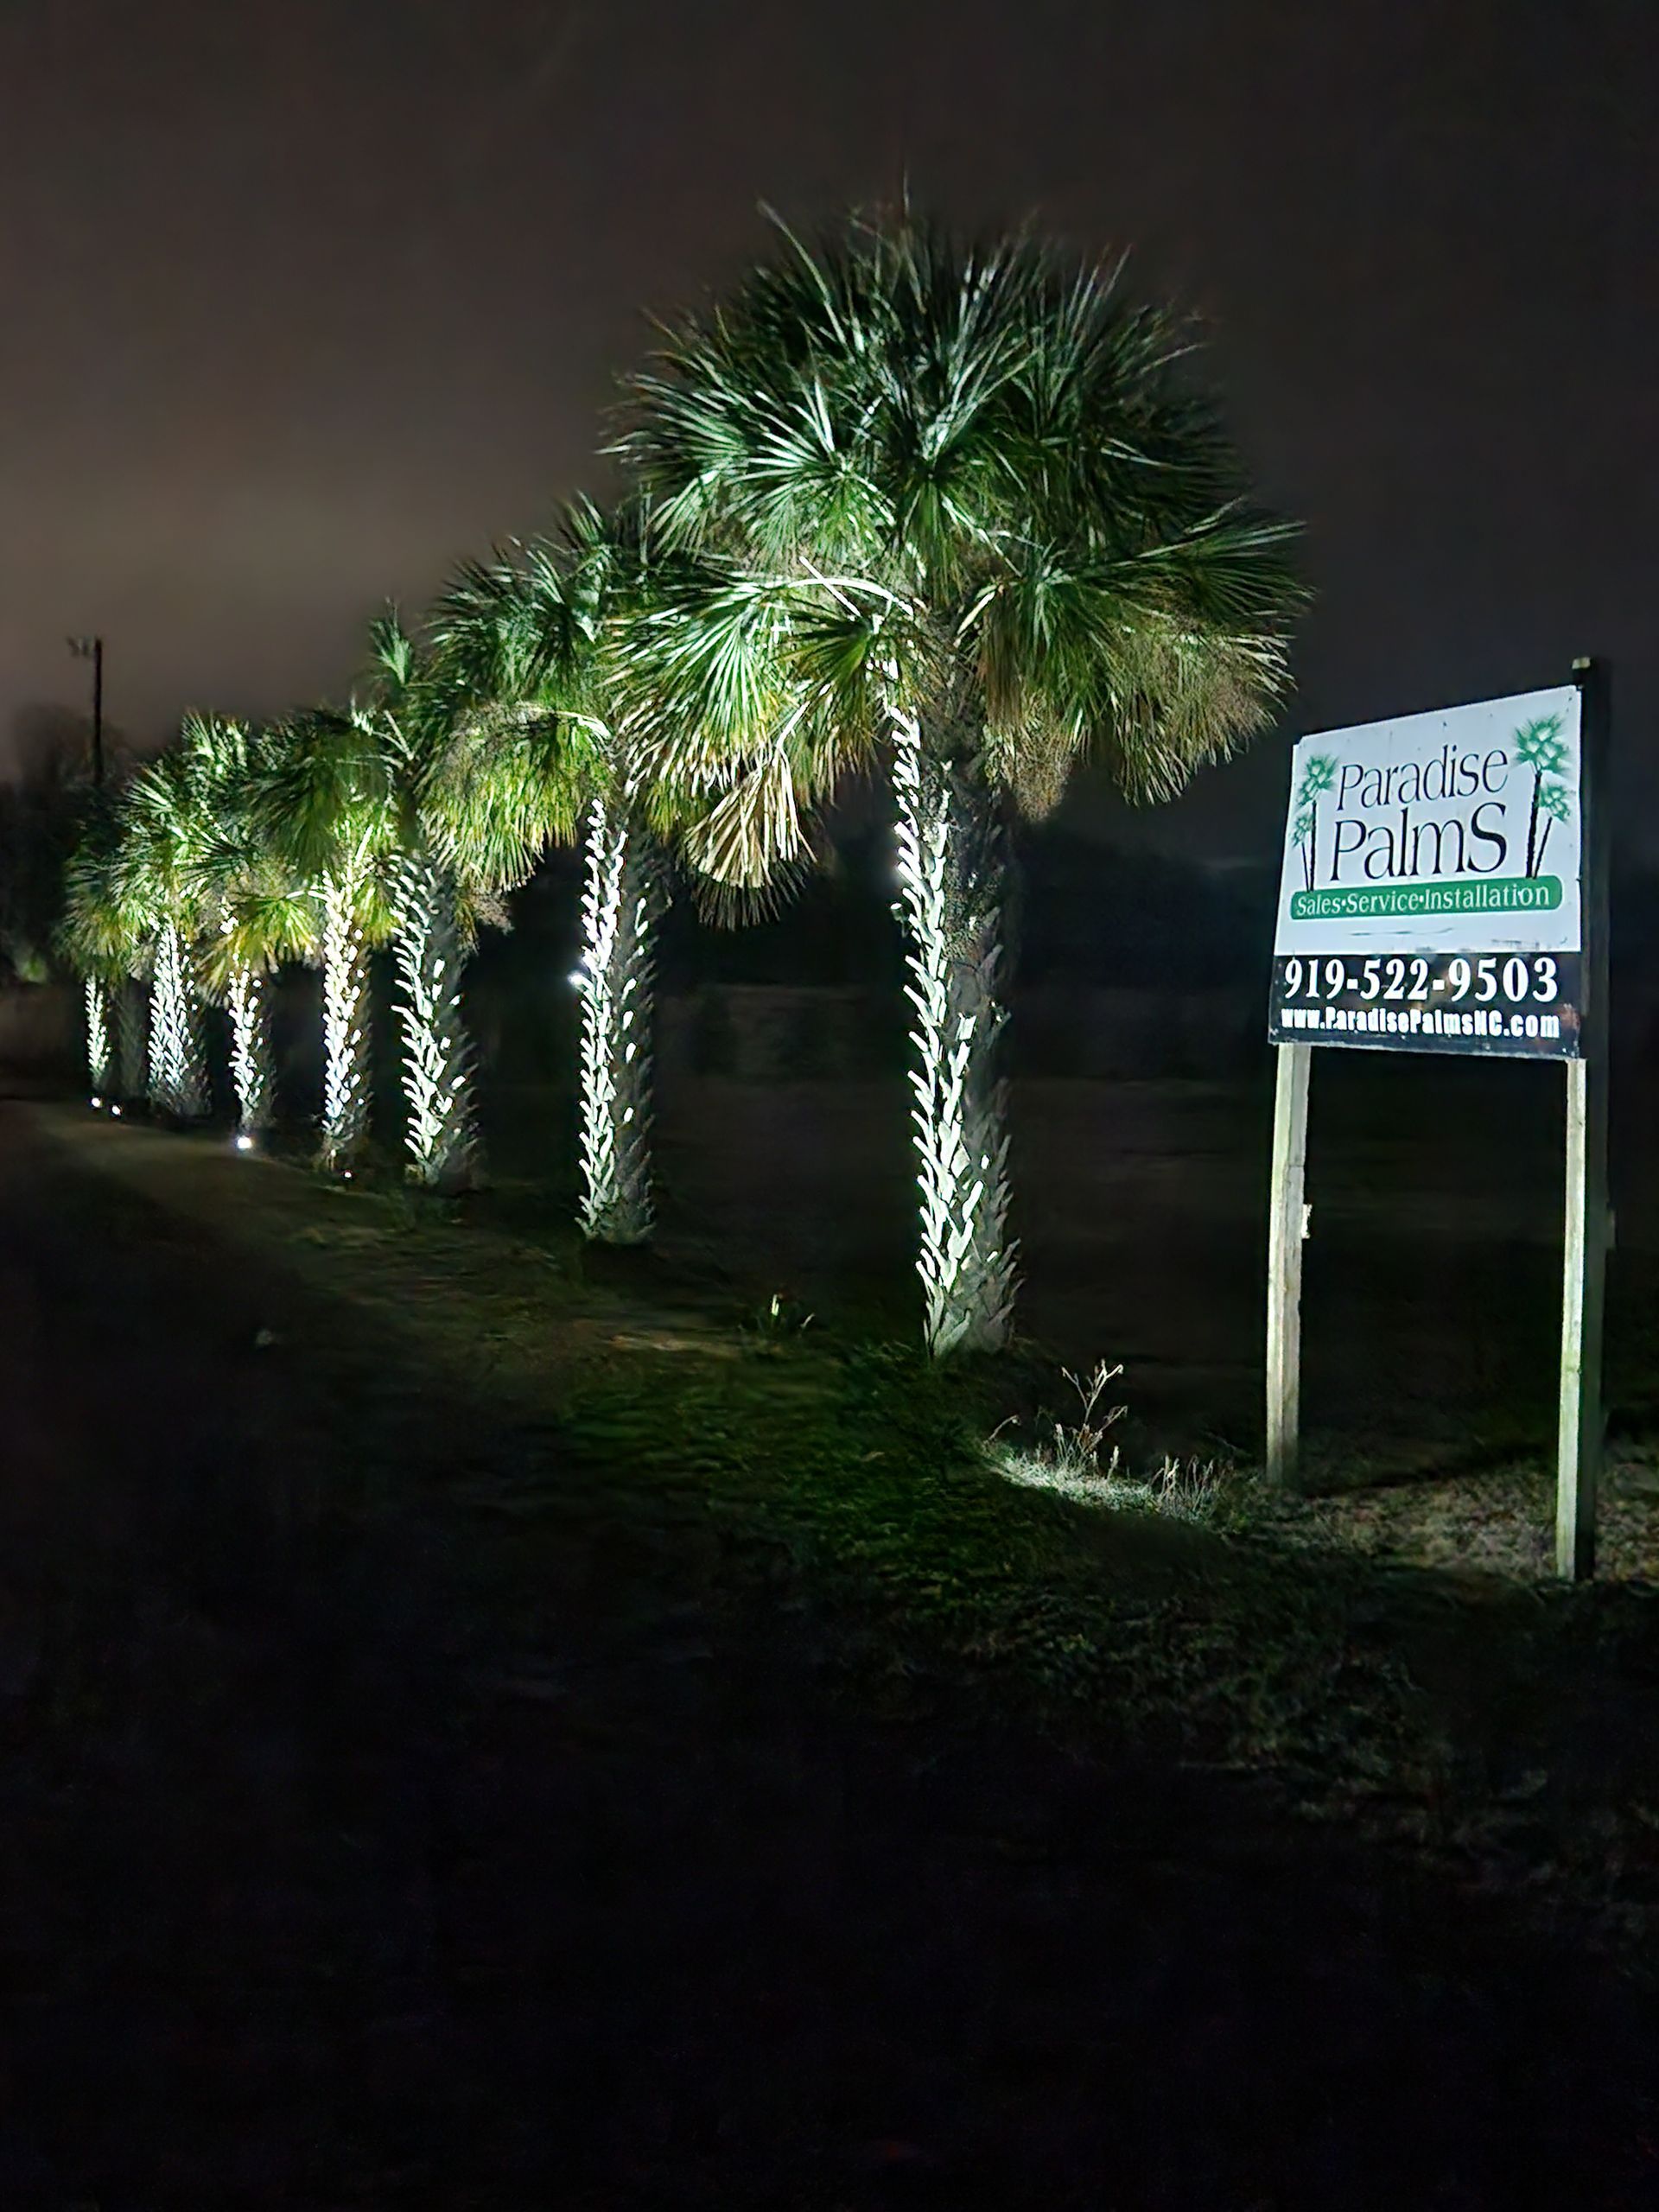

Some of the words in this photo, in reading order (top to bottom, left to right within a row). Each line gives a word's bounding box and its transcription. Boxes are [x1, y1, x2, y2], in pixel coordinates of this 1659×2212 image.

[1337, 745, 1509, 810] Paradise
[1330, 802, 1508, 881] PalmS
[1284, 957, 1558, 1002] 919-522-9503
[1281, 1007, 1560, 1038] www.ParadisePalmsNC.com
